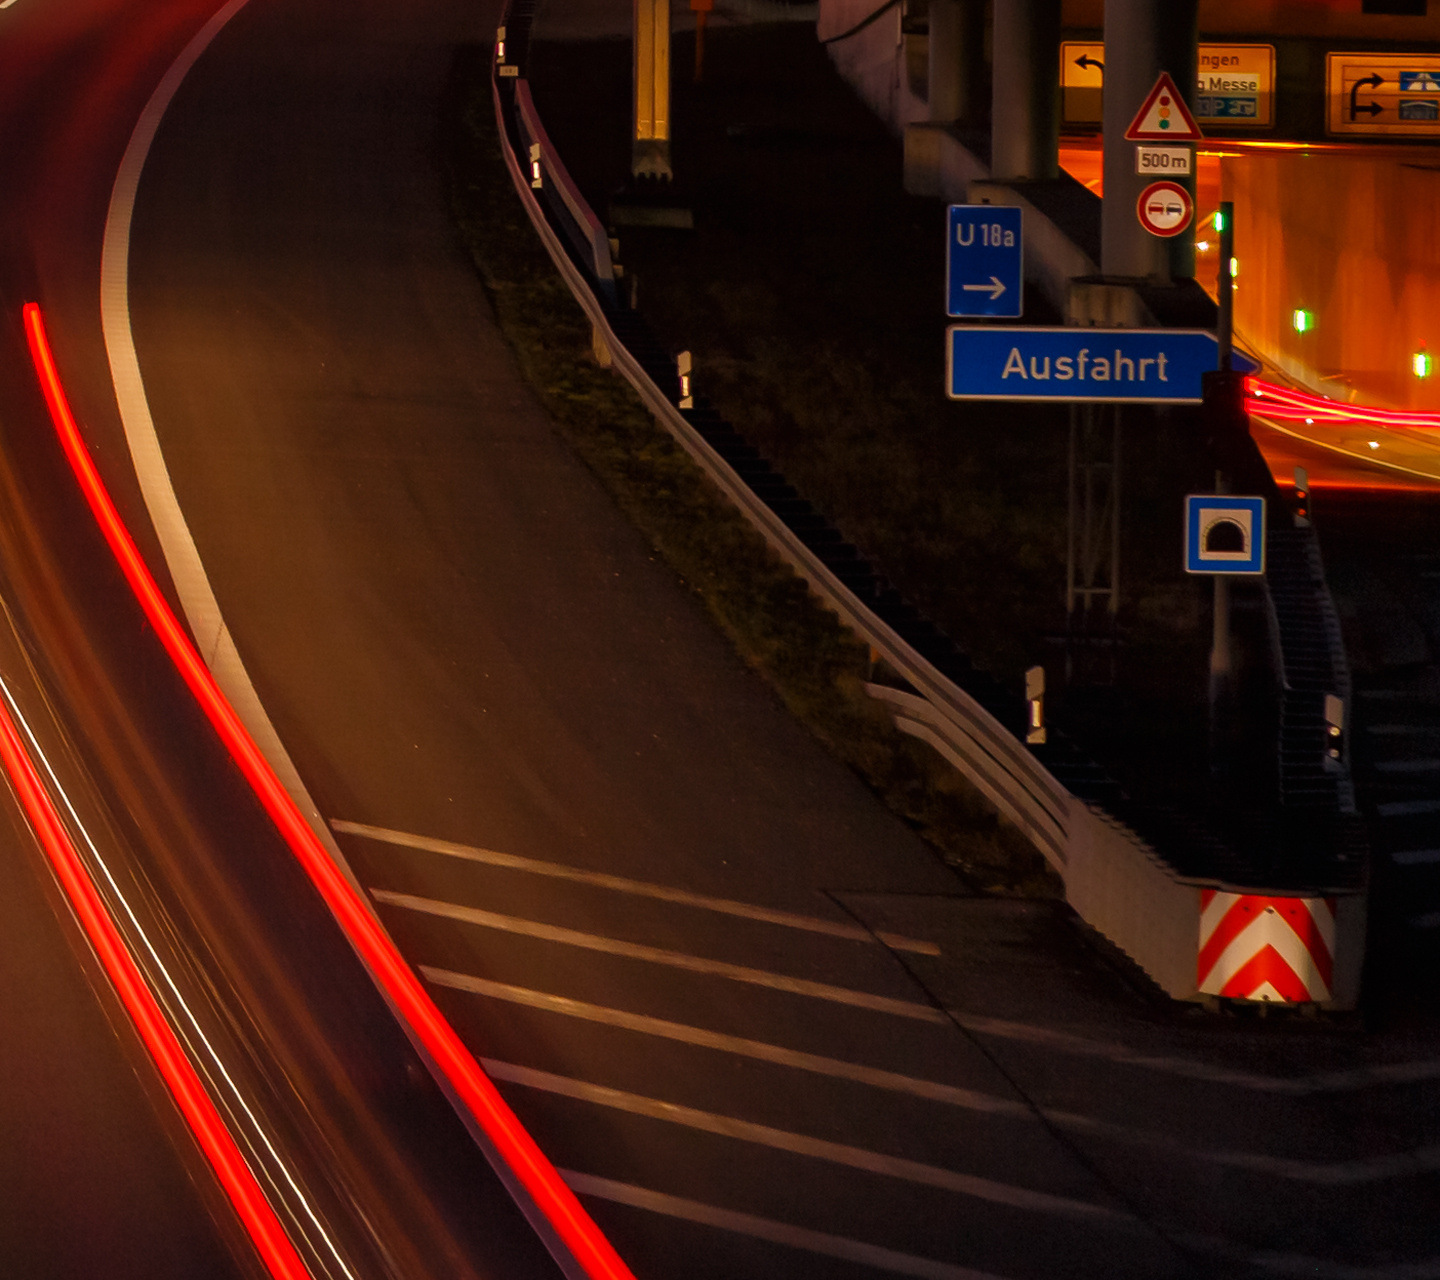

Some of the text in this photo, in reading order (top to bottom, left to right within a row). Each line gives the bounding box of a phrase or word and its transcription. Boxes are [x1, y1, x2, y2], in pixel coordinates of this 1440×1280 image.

[1201, 54, 1240, 69] ngen
[1209, 77, 1257, 91] Messe
[956, 223, 1014, 247] U 18a
[1001, 347, 1169, 382] Ausfahrt
